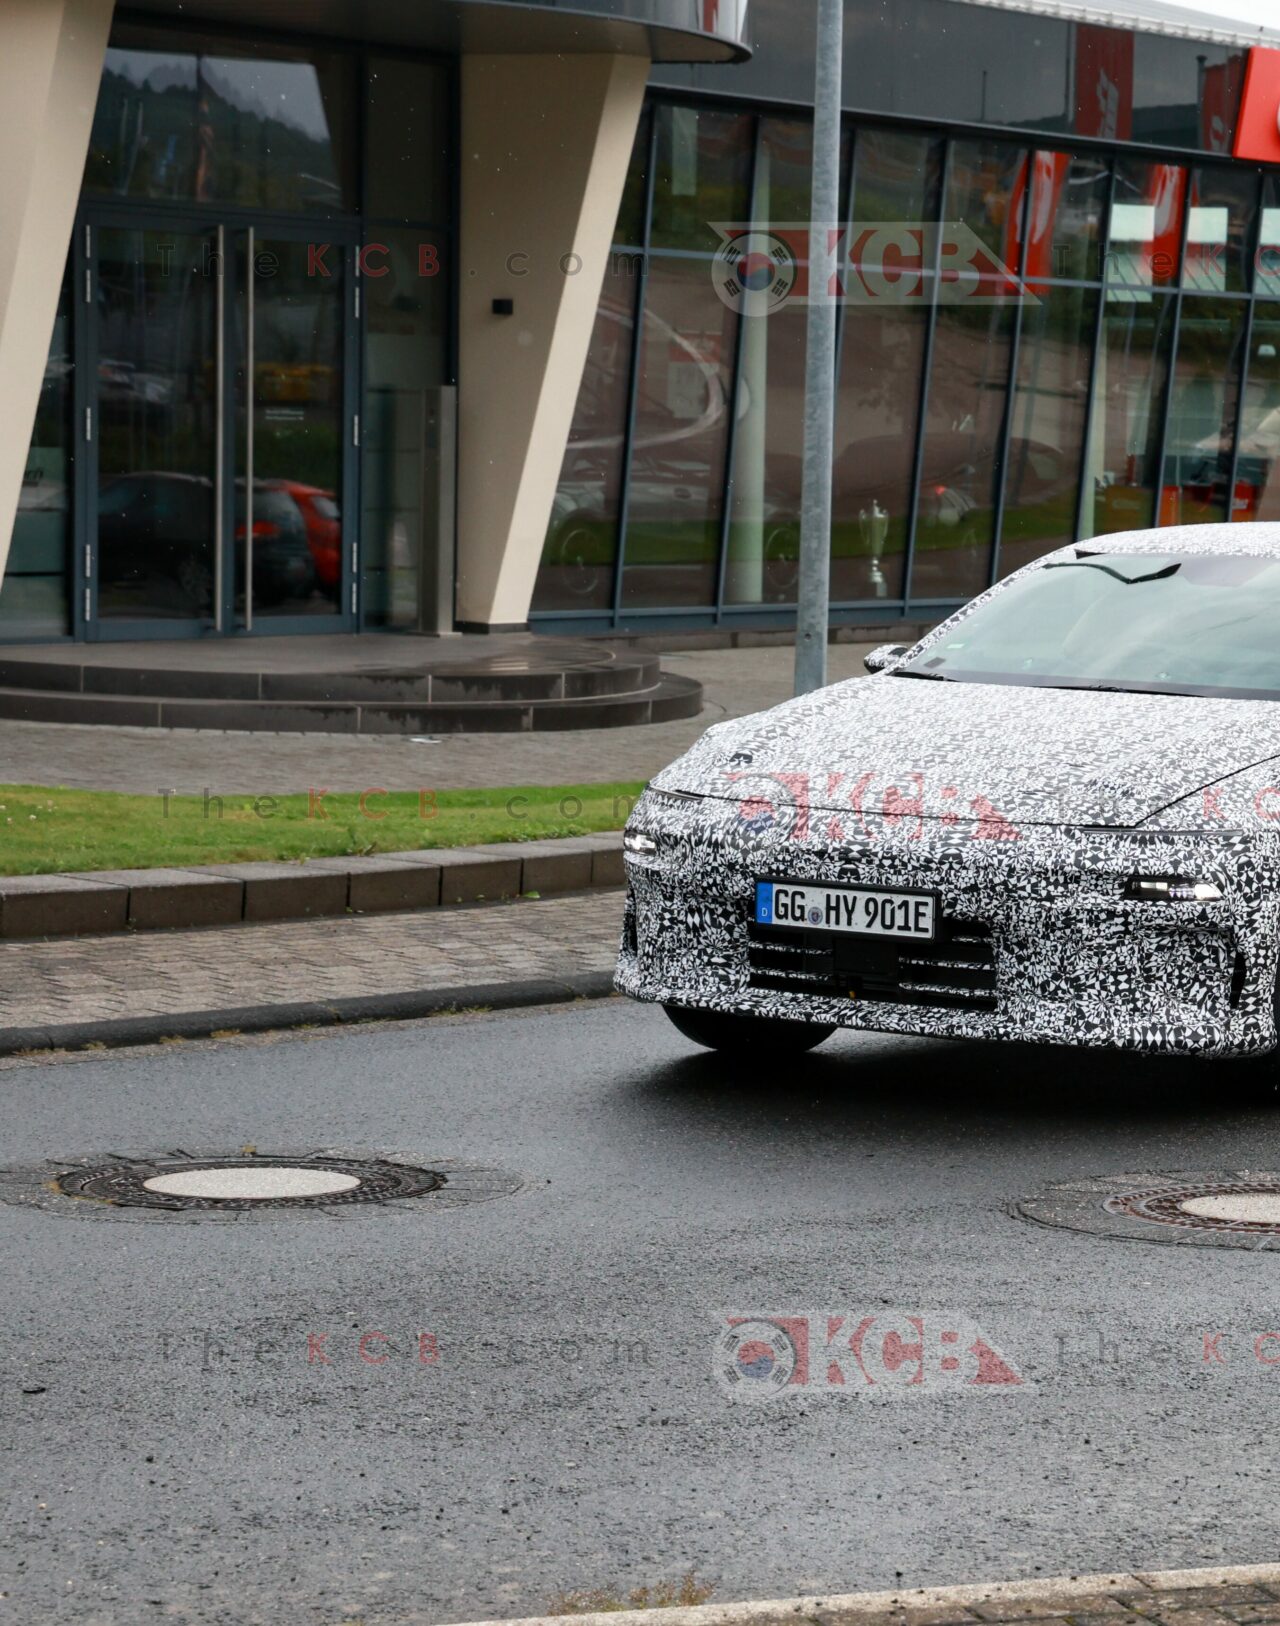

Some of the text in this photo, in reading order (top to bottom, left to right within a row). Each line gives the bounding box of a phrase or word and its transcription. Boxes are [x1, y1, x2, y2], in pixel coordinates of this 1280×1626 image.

[761, 907, 769, 917] D
[774, 888, 930, 933] GG HY 901E
